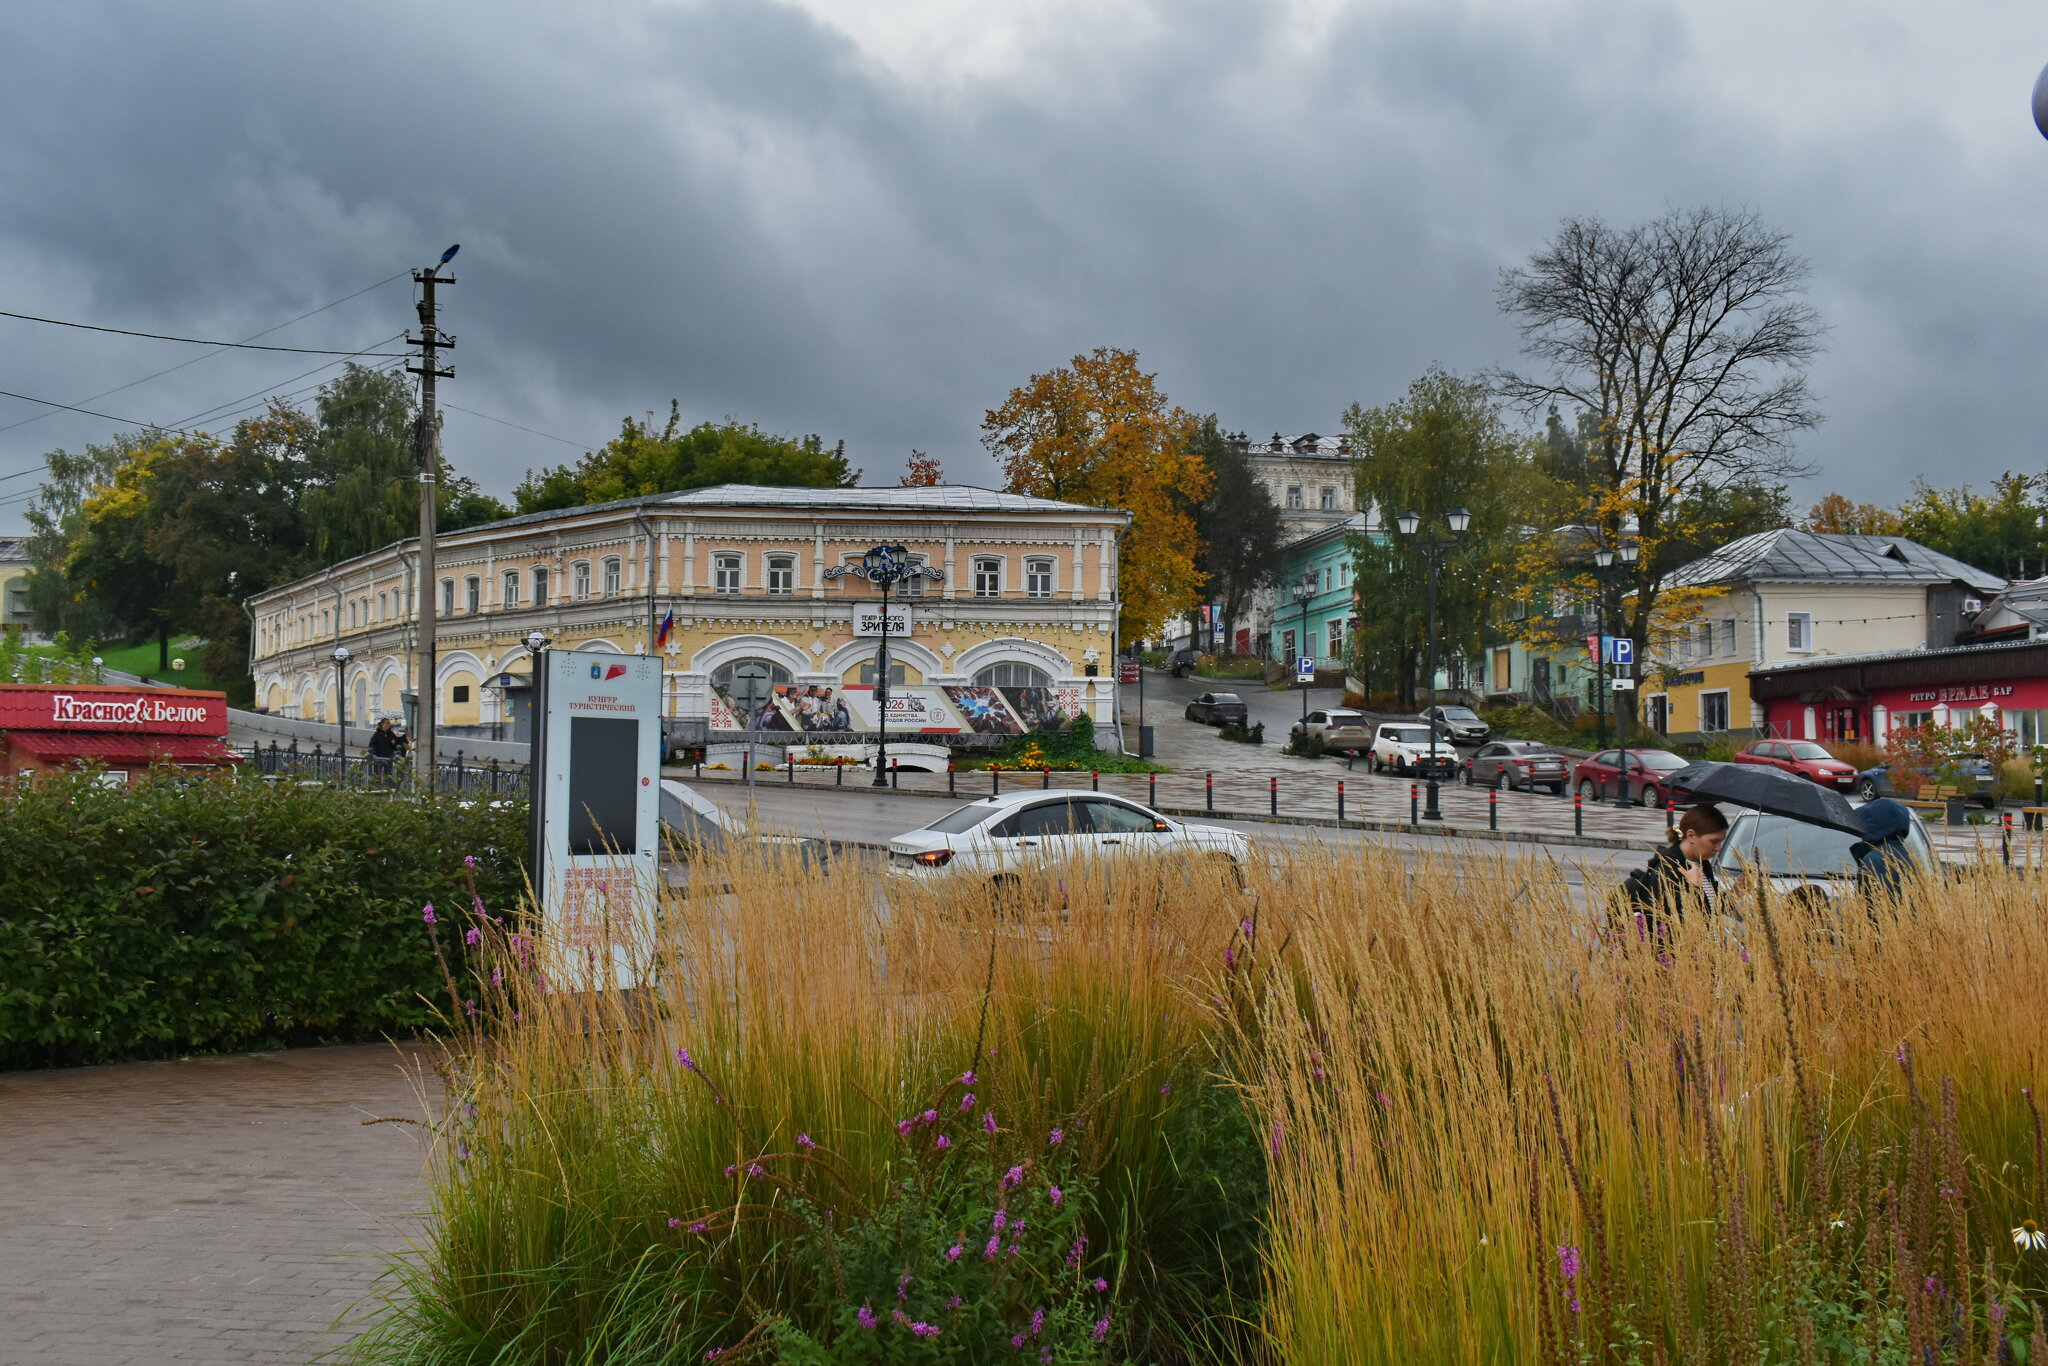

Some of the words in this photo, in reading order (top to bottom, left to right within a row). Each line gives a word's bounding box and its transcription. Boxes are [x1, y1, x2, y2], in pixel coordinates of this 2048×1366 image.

[1217, 623, 1224, 632] P
[1617, 640, 1631, 662] P
[1301, 658, 1312, 673] P
[588, 695, 618, 703] КУНГУР
[1910, 692, 1937, 702] РЕТРО
[1993, 686, 2013, 696] БАР
[569, 702, 636, 712] ТУРИСТИЧЕСКИЙ
[878, 699, 905, 710] 026
